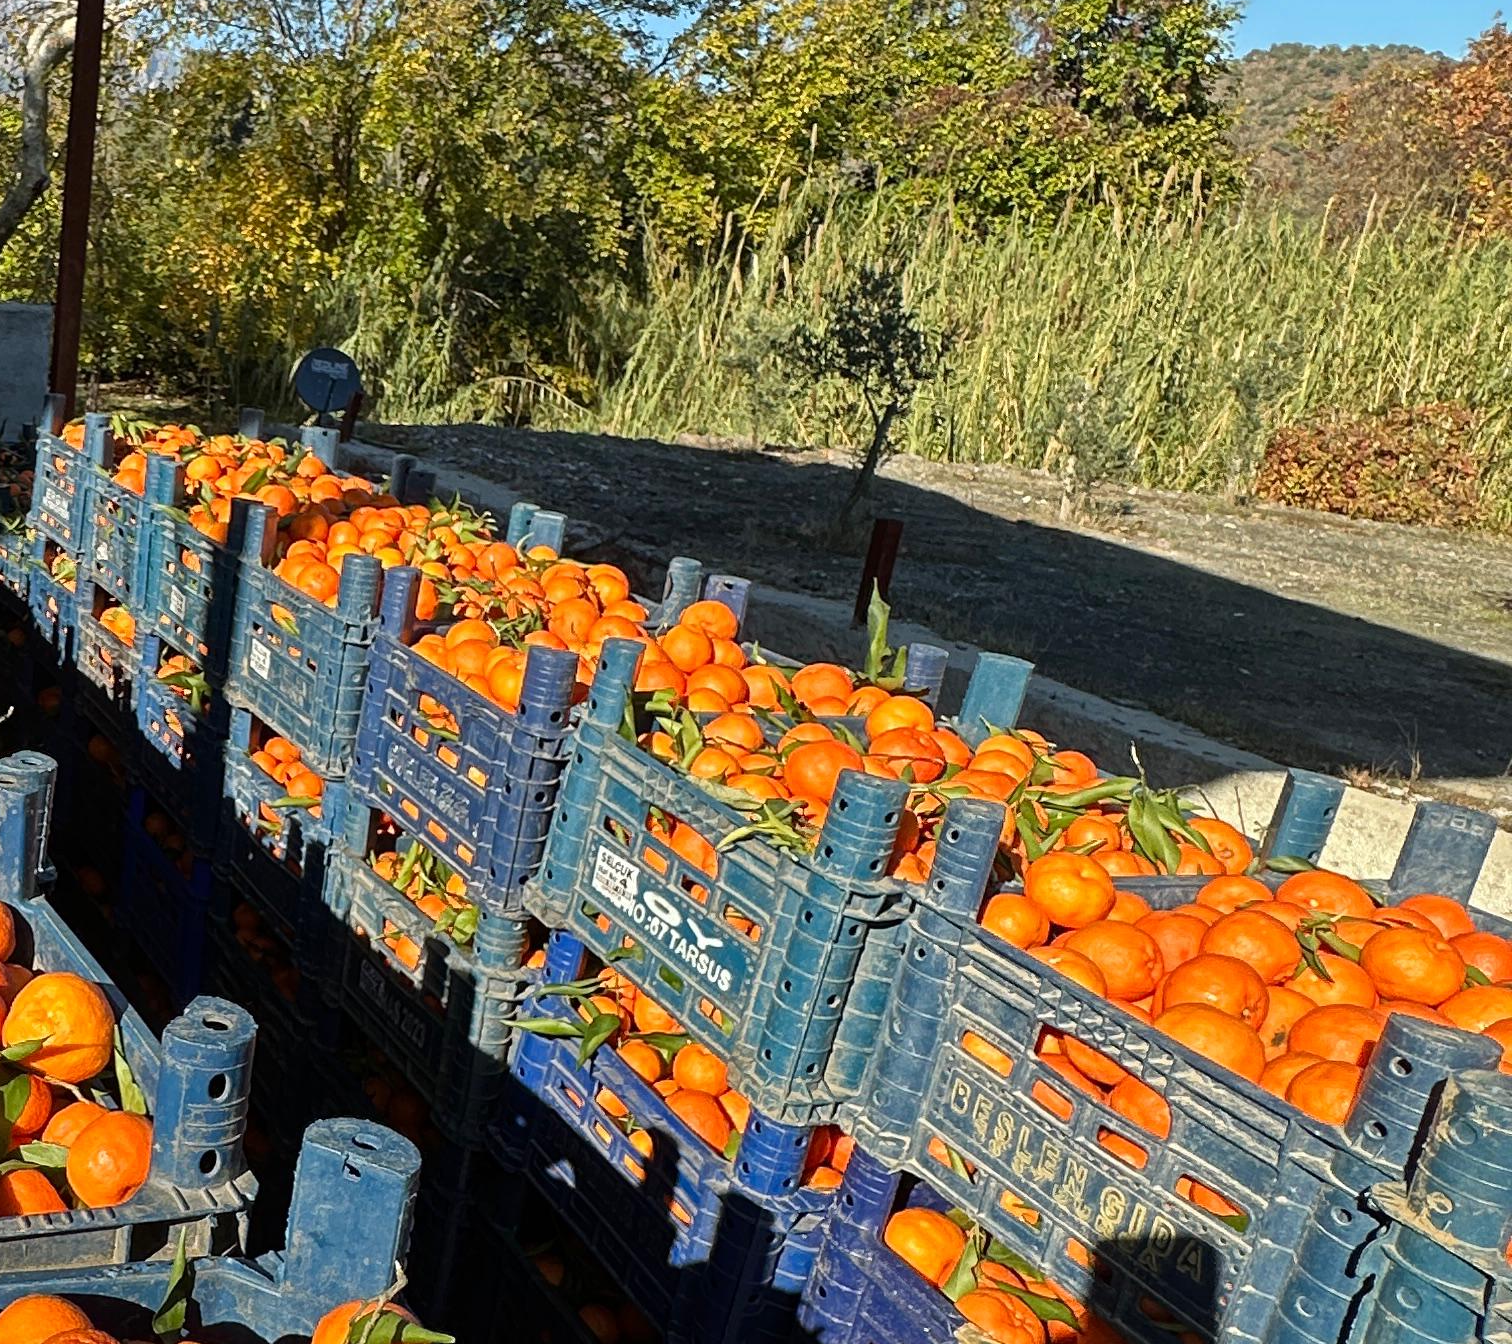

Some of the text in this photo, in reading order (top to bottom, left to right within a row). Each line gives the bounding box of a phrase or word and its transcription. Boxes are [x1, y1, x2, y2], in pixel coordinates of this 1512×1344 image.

[600, 852, 635, 881] SELÇUK
[619, 878, 628, 889] 4
[669, 929, 734, 992] TARSUS
[950, 1077, 1090, 1202] BESLEN
